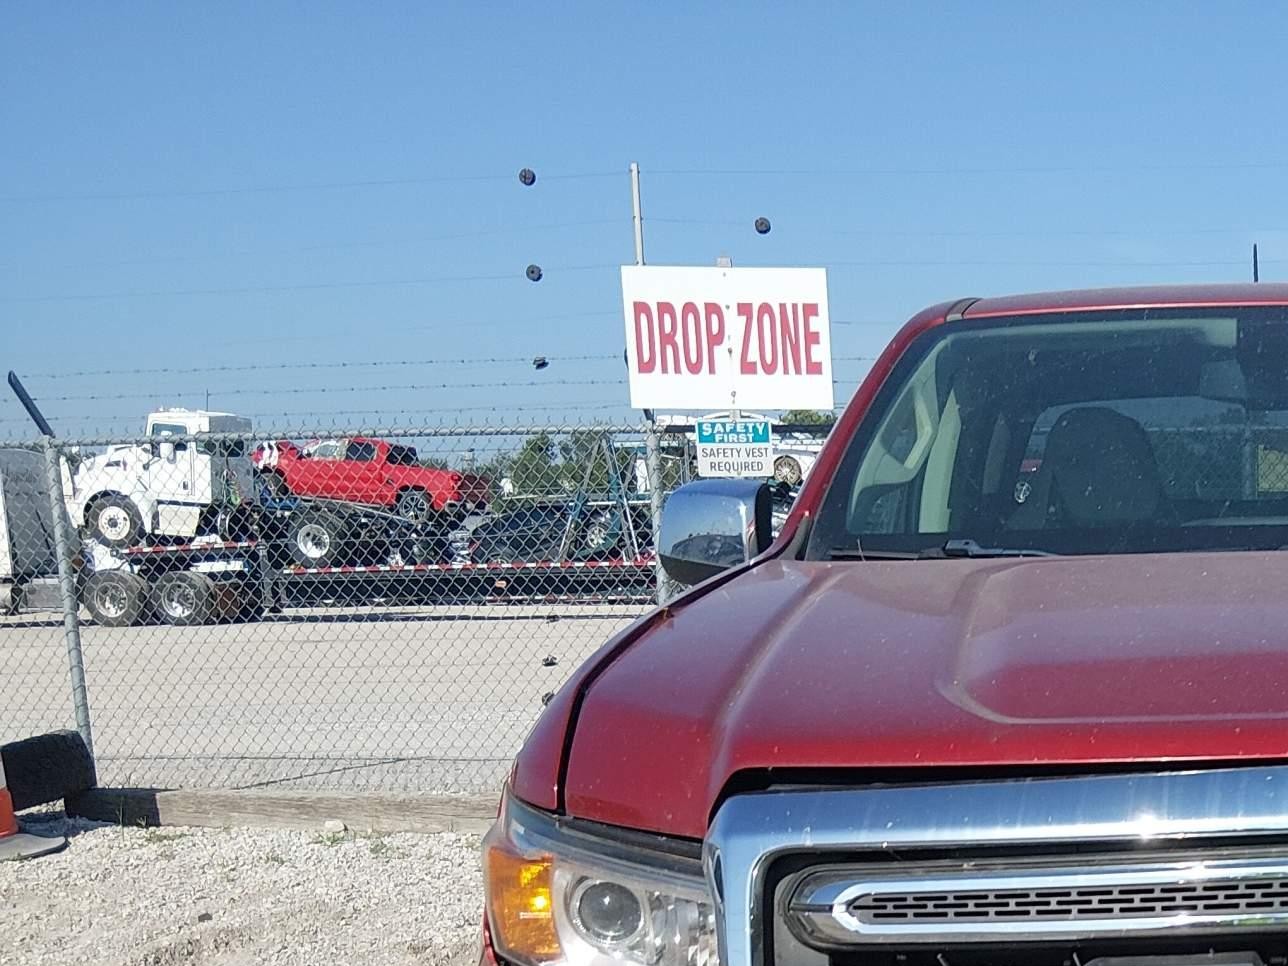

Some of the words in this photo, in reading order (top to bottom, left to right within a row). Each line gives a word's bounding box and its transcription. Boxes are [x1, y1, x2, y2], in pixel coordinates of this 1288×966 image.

[634, 301, 725, 374] DROP
[737, 303, 823, 374] ZONE
[702, 422, 766, 437] SAFETY
[714, 433, 755, 443] FIRST
[701, 447, 742, 458] SAFETY
[746, 447, 769, 457] VEST
[709, 460, 764, 472] REQUIRED
